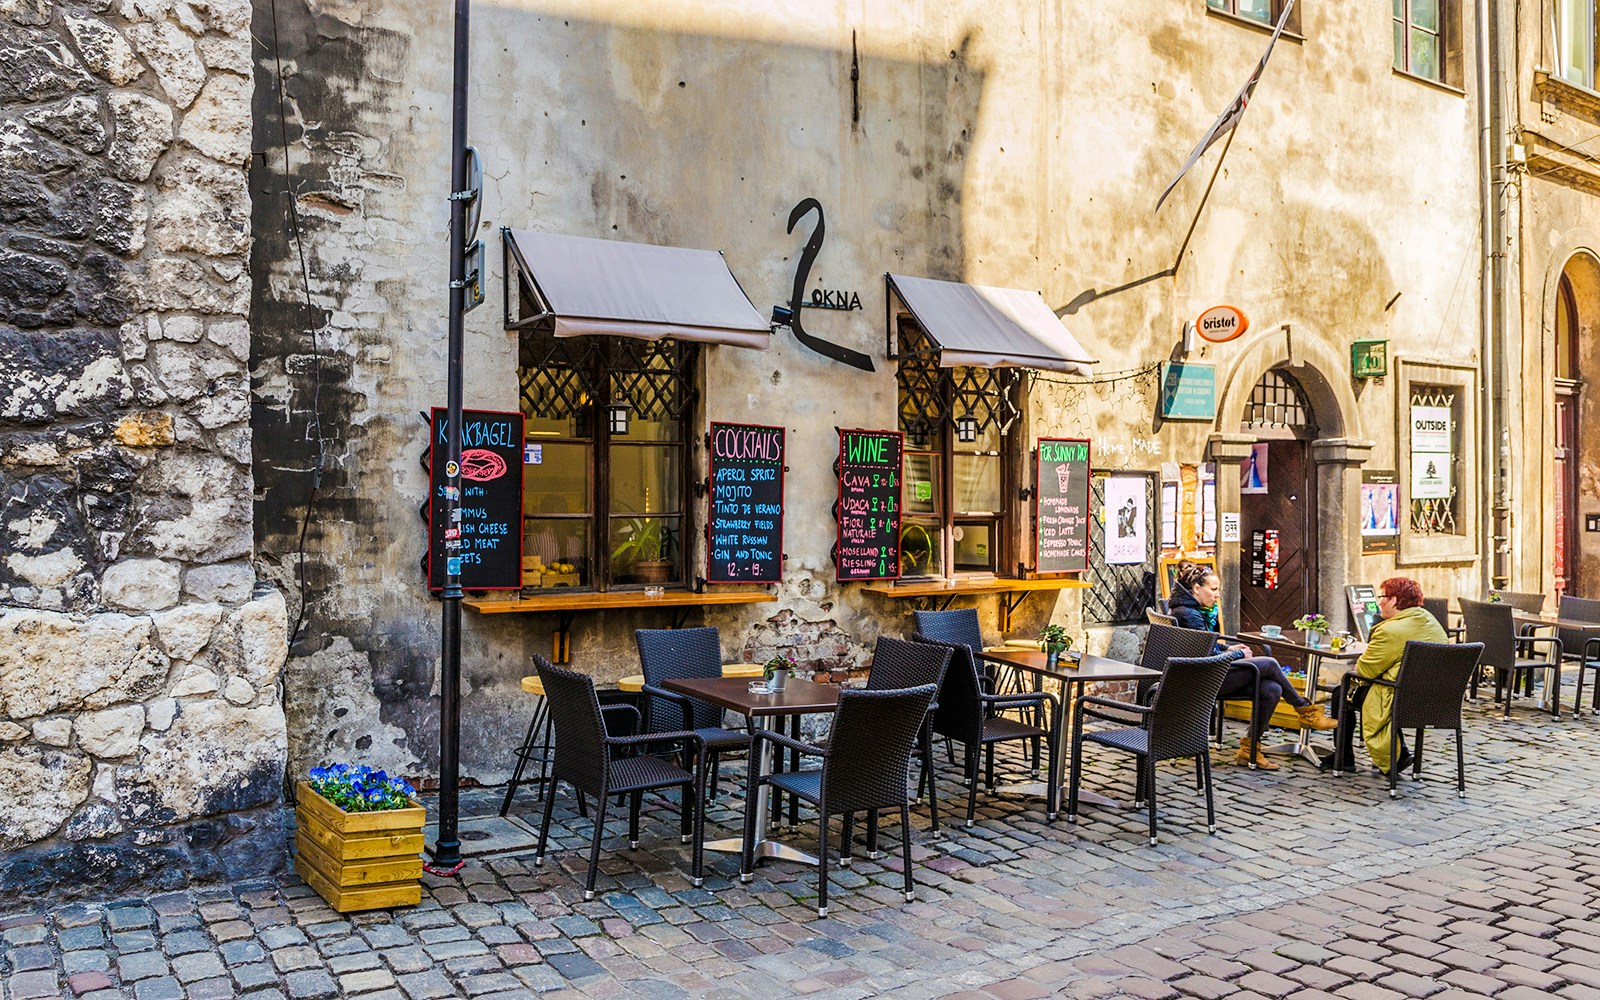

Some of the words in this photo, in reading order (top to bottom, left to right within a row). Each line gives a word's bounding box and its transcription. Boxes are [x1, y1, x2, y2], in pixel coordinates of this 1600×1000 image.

[787, 198, 875, 372] 2
[812, 289, 863, 310] OKNA
[1203, 316, 1235, 329] bristot
[1415, 420, 1446, 431] OUTSIDE
[715, 428, 780, 461] COCKTAILS
[848, 435, 889, 463] WINE
[1098, 436, 1125, 456] HOME
[1132, 437, 1161, 455] MADE
[1040, 443, 1052, 461] FOR
[716, 467, 746, 481] APEROL
[750, 468, 775, 481] SPRITZ
[843, 471, 871, 488] CAVA
[716, 485, 752, 502] MOJITO
[715, 500, 739, 514] TINTO
[741, 504, 751, 515] DE
[755, 504, 781, 515] VERANO
[479, 523, 508, 535] CHEESE
[754, 520, 774, 530] FIELDS
[842, 516, 864, 529] FIORI
[842, 528, 877, 538] NATURALE
[1058, 526, 1075, 536] LATTE
[475, 538, 500, 549] MEAT
[715, 534, 739, 545] WHITE
[742, 534, 768, 546] RUSSIAN
[714, 548, 730, 560] GIN
[735, 550, 749, 560] AND
[750, 548, 773, 560] TONIC
[842, 547, 879, 557] MOSELLAND
[1043, 549, 1070, 558] HOMEMADE
[841, 558, 876, 568] RIESLING
